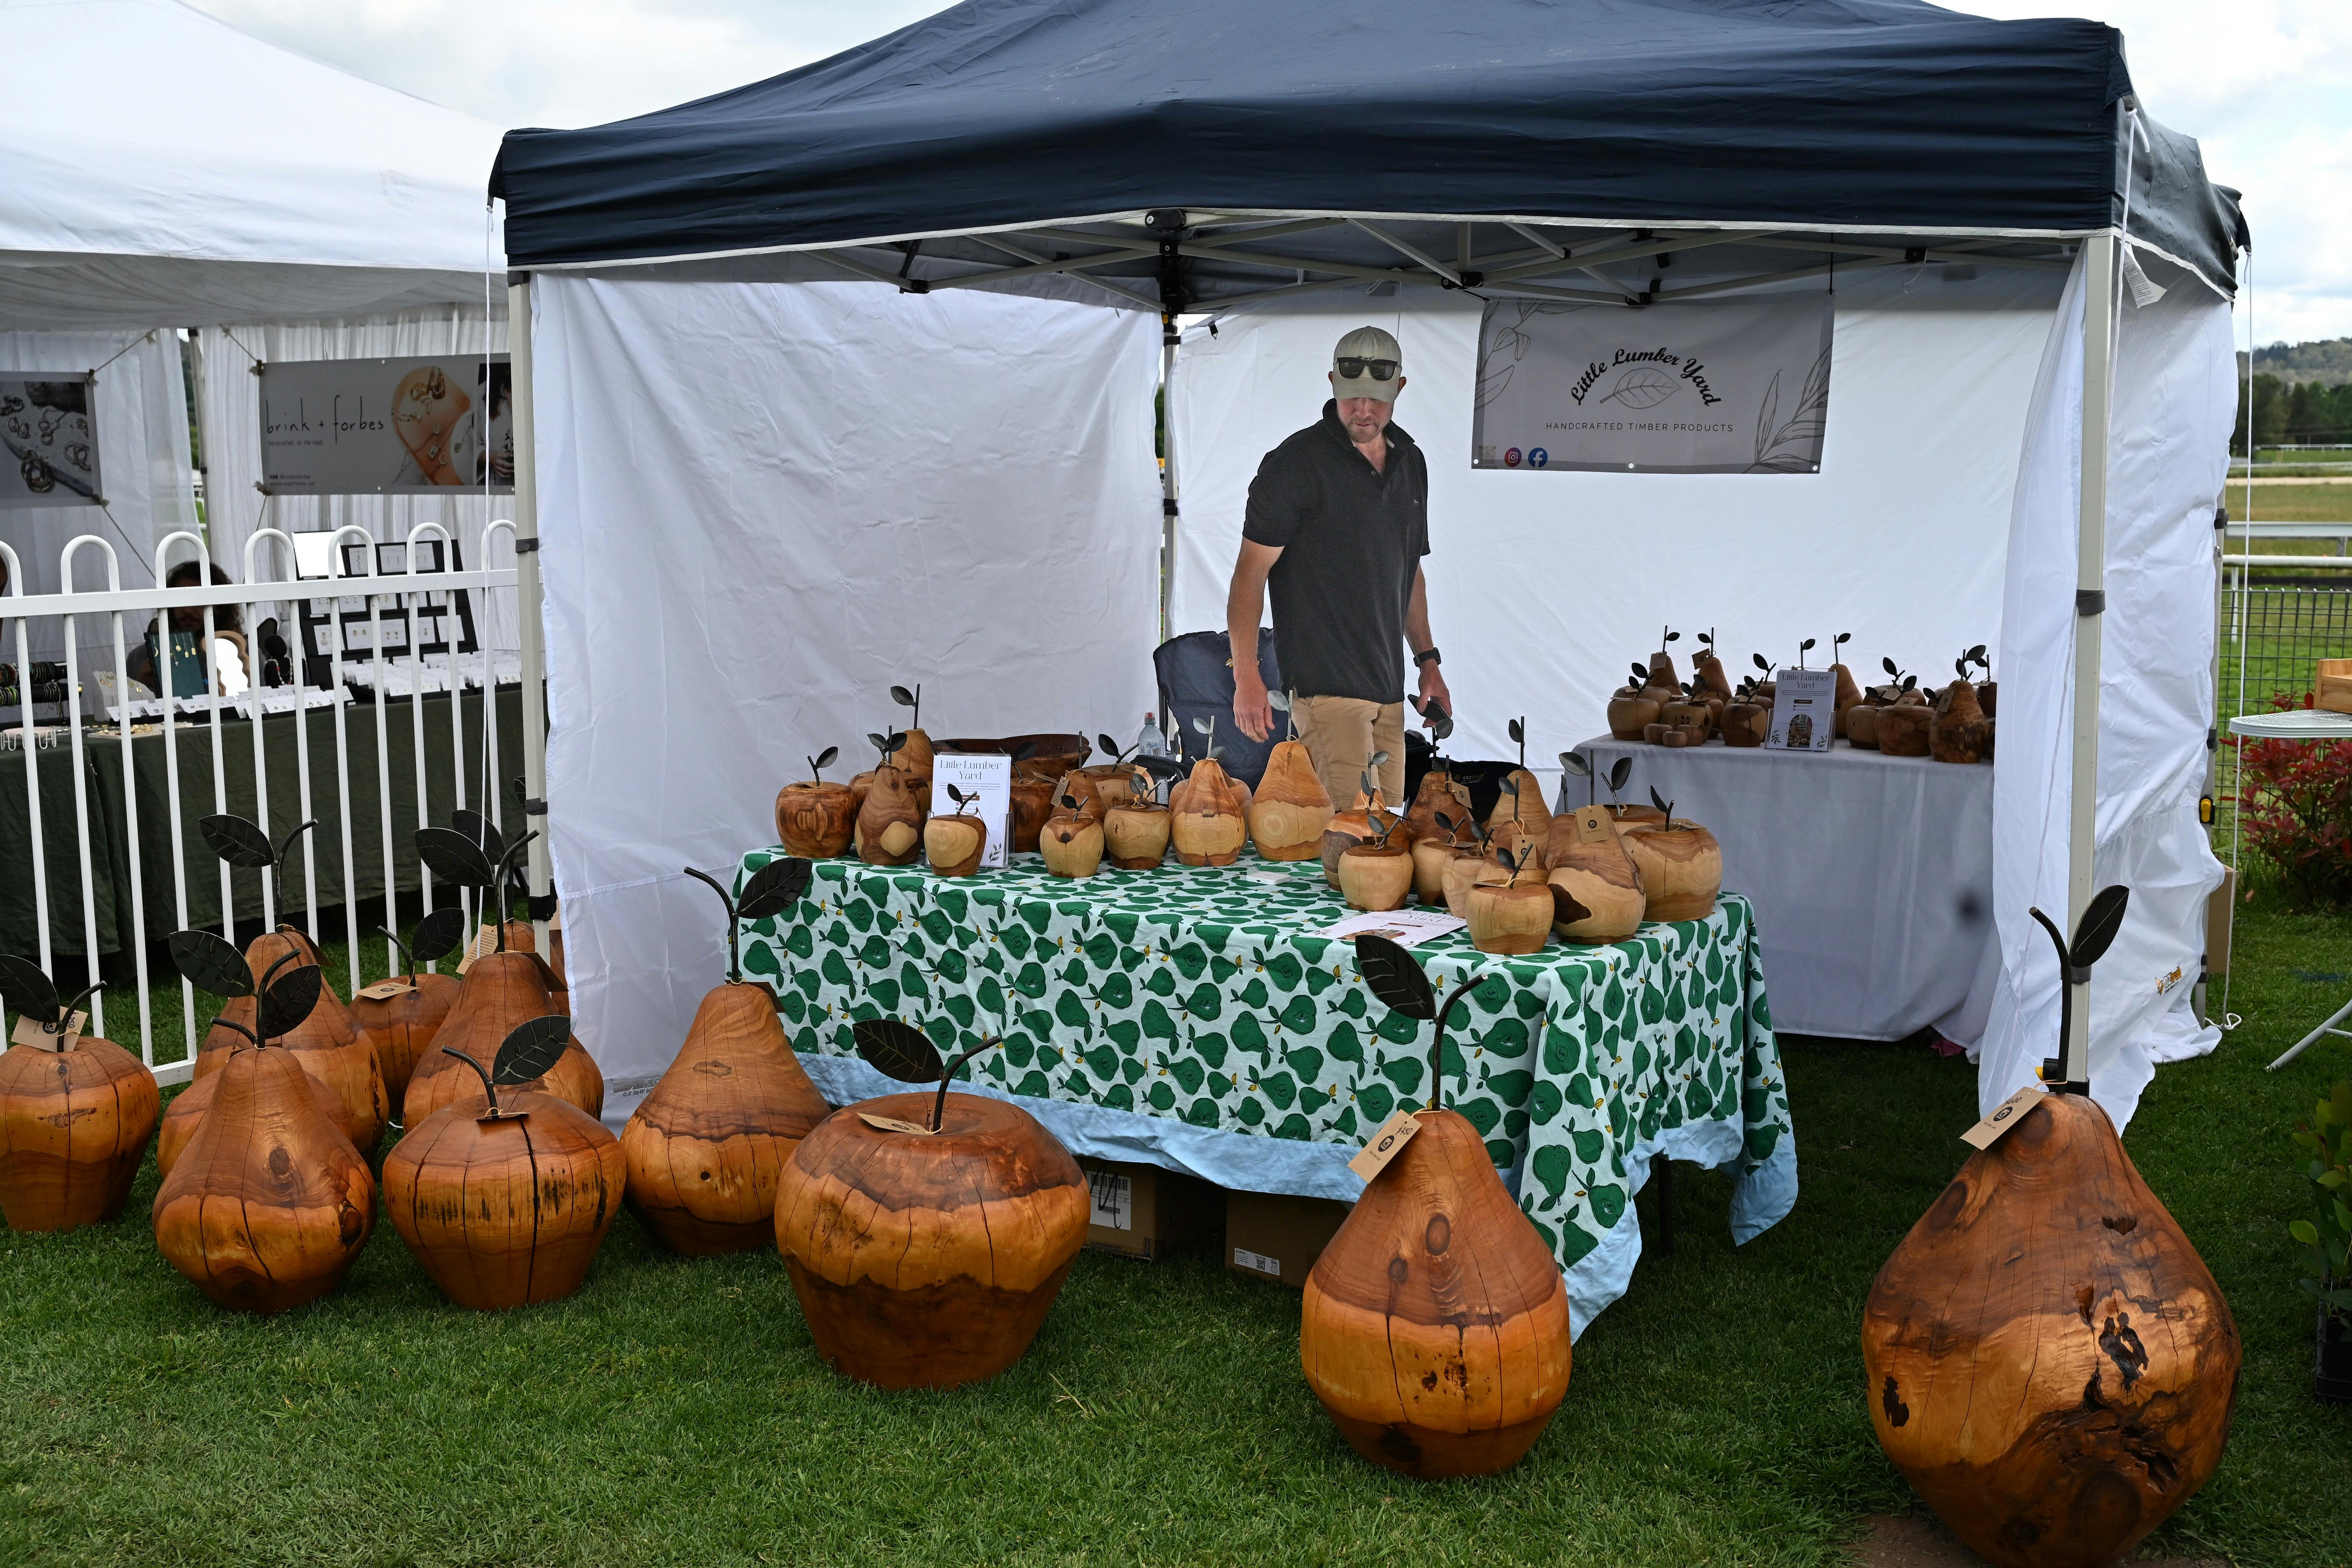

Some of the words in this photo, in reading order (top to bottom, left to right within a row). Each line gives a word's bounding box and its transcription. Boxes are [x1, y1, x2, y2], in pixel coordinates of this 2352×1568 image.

[1571, 362, 1608, 406] Little
[1612, 347, 1680, 367] Lumber
[1680, 358, 1722, 406] Yard
[266, 398, 310, 434] brink
[333, 395, 384, 444] forbes
[1673, 424, 1733, 432] PRODUCTS
[940, 760, 961, 769] Little
[964, 760, 1002, 770] Lumber
[959, 771, 982, 780] Yard
[1420, 913, 1465, 922] Lumbe
